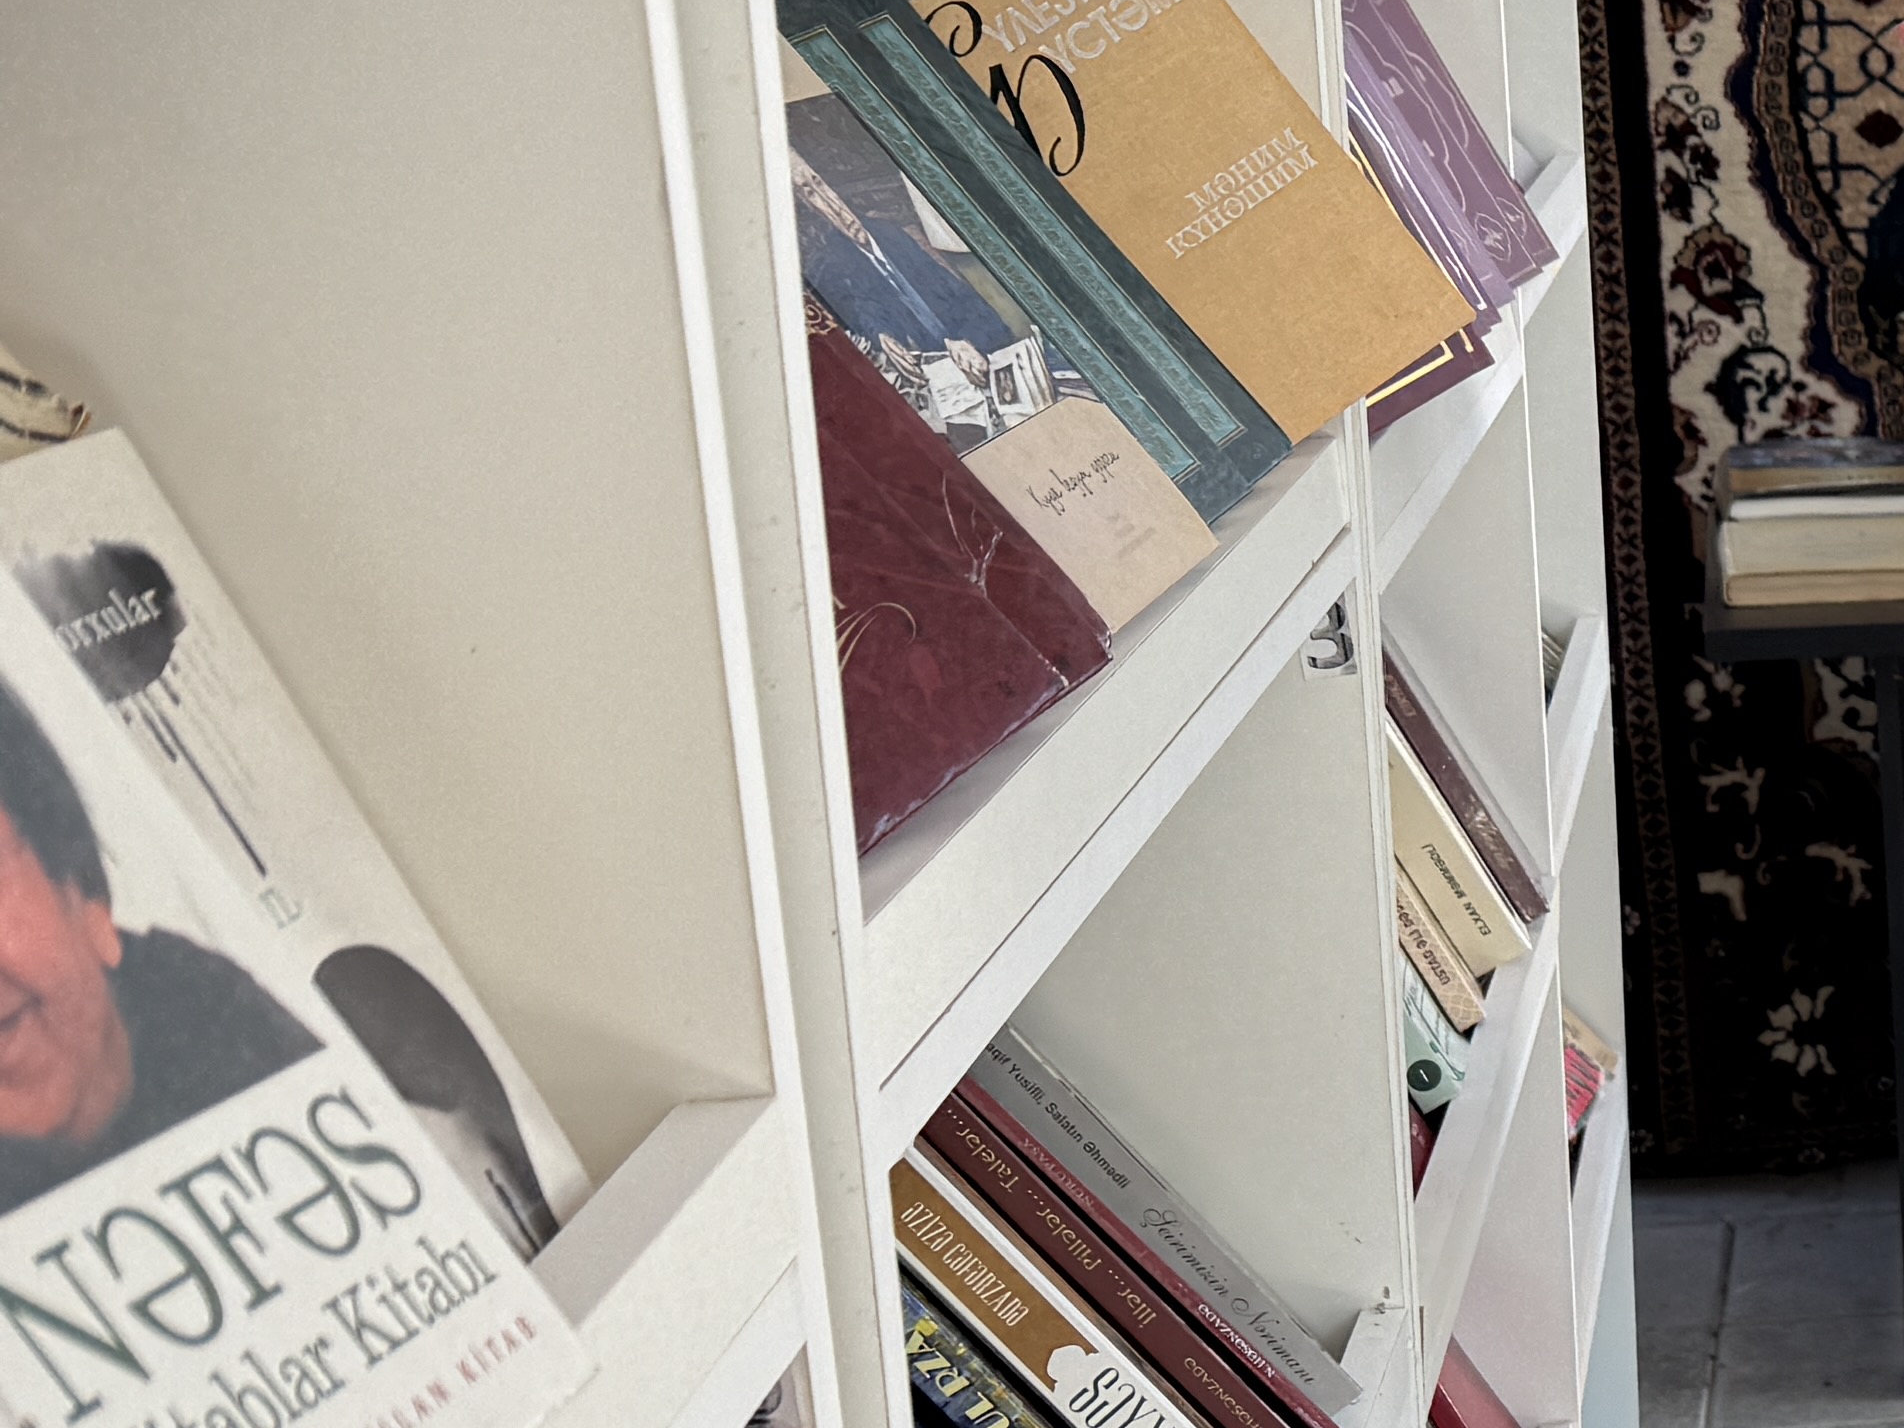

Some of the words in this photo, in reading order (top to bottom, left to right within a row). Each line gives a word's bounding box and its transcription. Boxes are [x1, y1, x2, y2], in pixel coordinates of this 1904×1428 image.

[54, 587, 161, 651] orxular
[985, 1043, 1011, 1066] aqif
[322, 1237, 500, 1369] Kitabı
[905, 1330, 972, 1398] RZA
